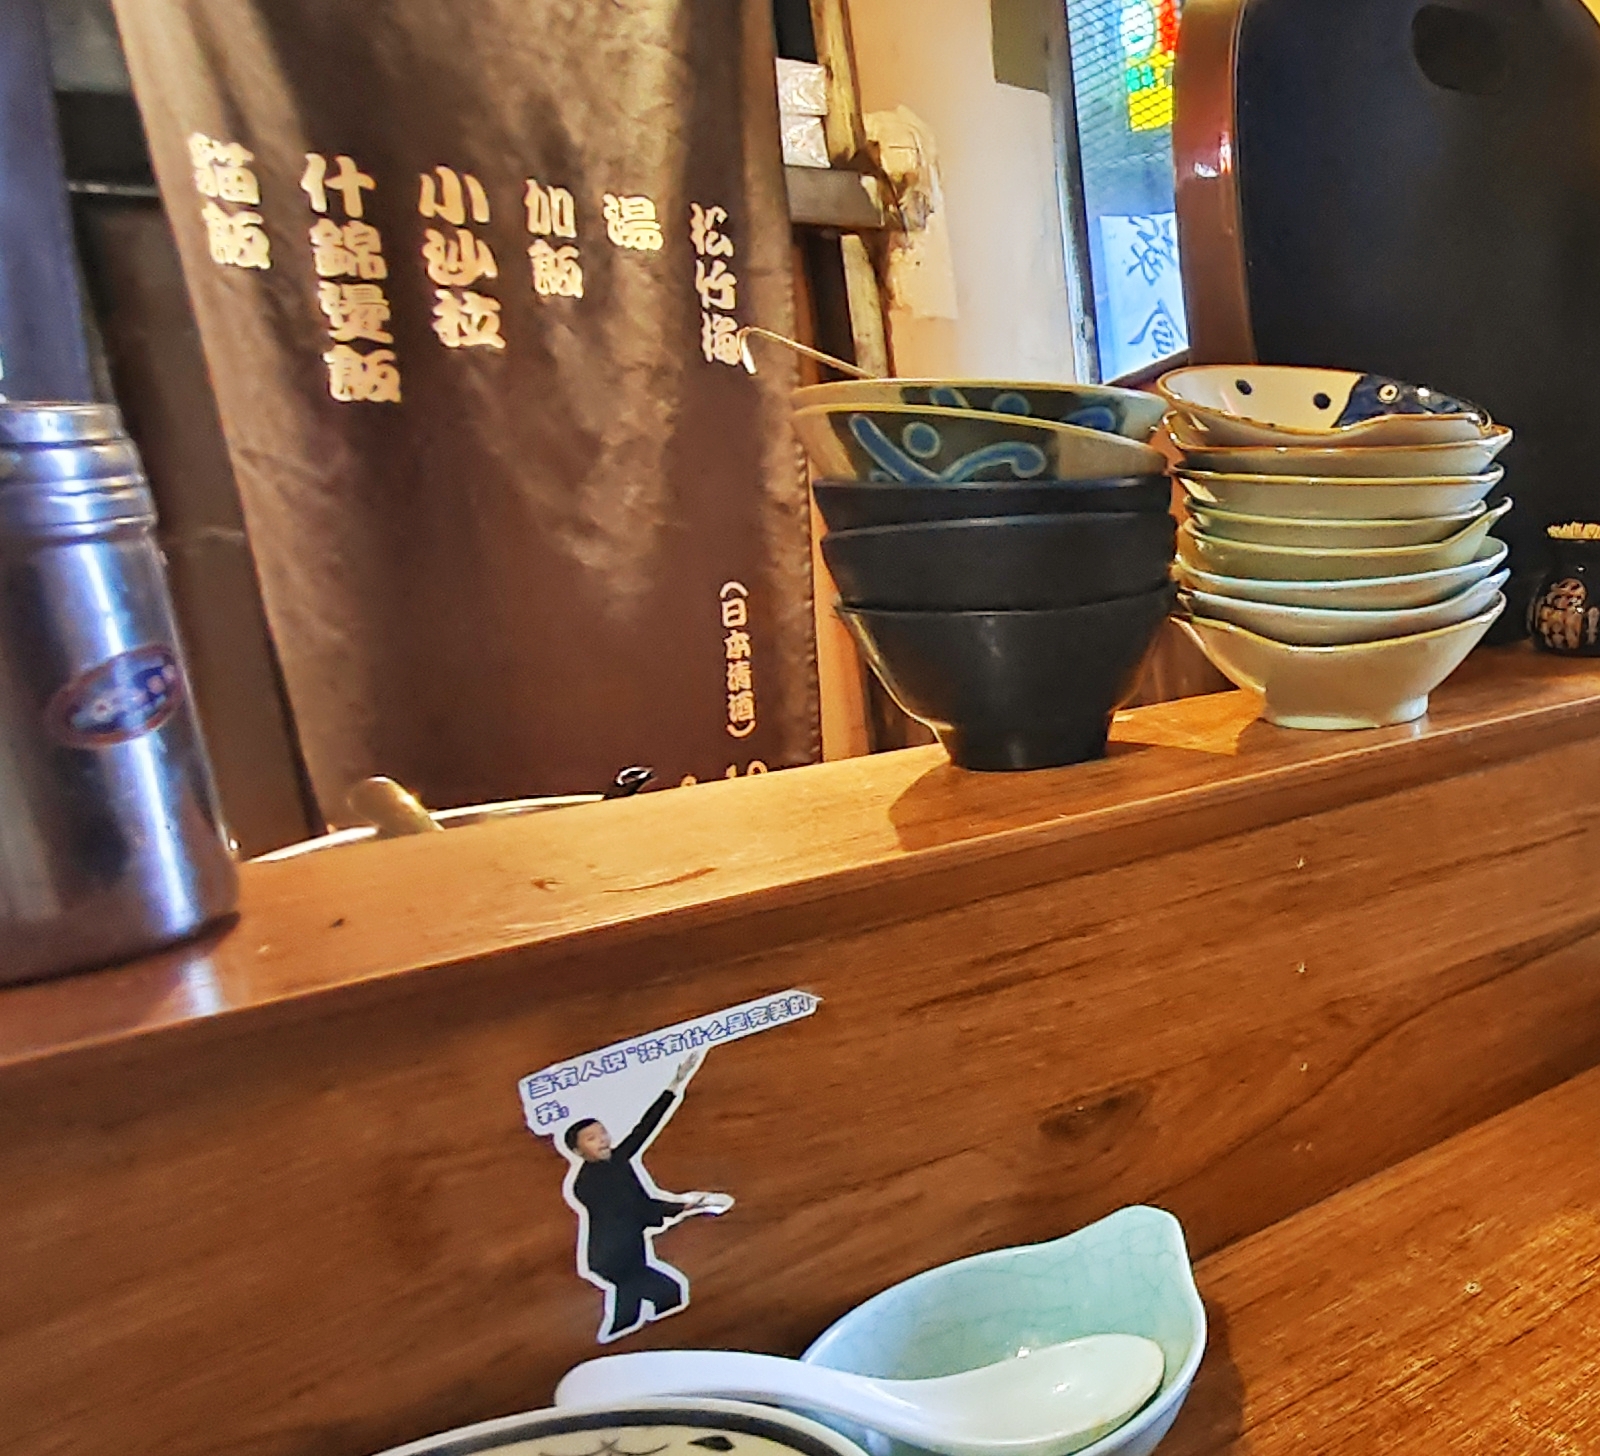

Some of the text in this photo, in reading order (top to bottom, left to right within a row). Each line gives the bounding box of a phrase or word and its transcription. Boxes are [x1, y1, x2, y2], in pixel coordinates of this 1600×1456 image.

[418, 165, 506, 348] 小沙拉
[525, 178, 584, 299] 加飯
[603, 193, 664, 251] 湯
[689, 202, 739, 366] 松竹梅
